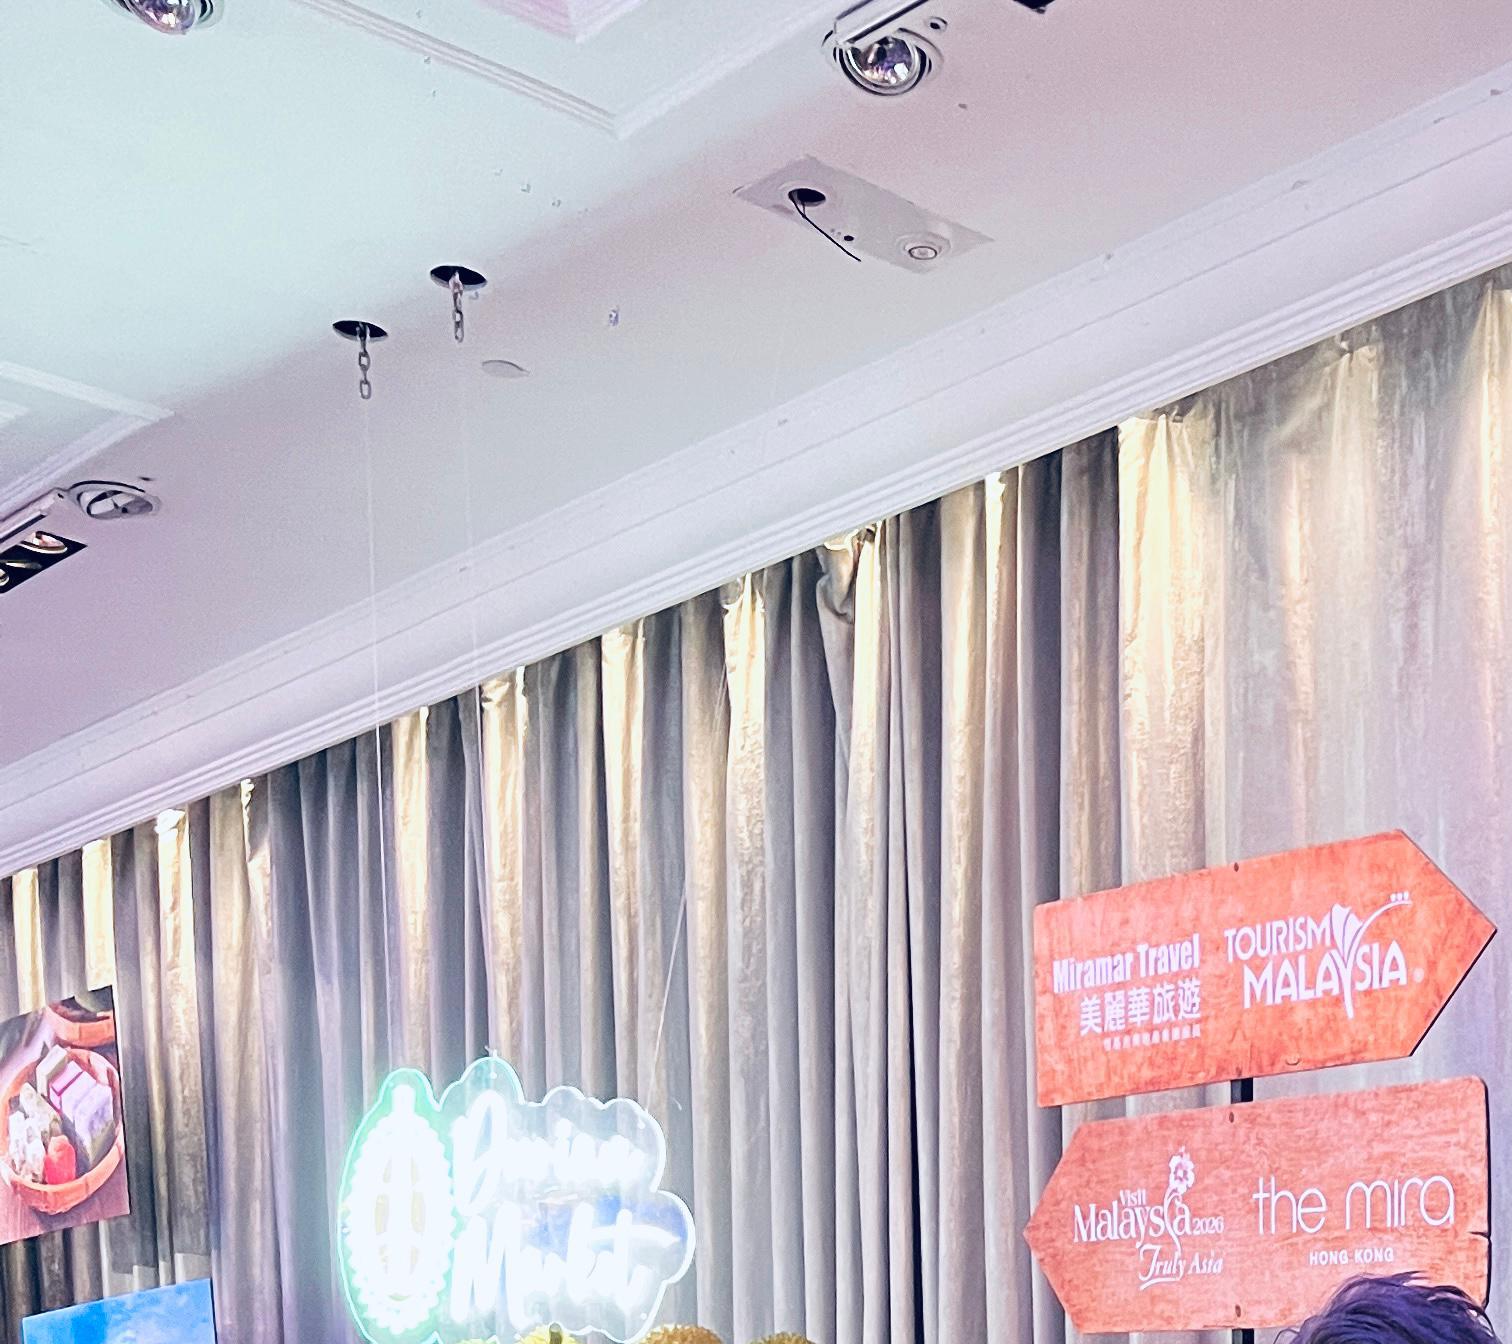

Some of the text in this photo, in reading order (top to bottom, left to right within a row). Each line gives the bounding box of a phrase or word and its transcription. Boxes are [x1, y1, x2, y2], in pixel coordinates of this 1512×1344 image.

[1053, 932, 1200, 994] Miramar Travel
[1224, 914, 1332, 964] TOURISM
[1080, 976, 1201, 1037] 美麗華旅遊
[1243, 940, 1408, 1019] MALAYSIA
[1192, 1216, 1225, 1236] 2026
[1252, 1174, 1455, 1236] the mira
[1138, 1243, 1224, 1288] Truly Asia
[1309, 1246, 1395, 1266] HONG KONG
